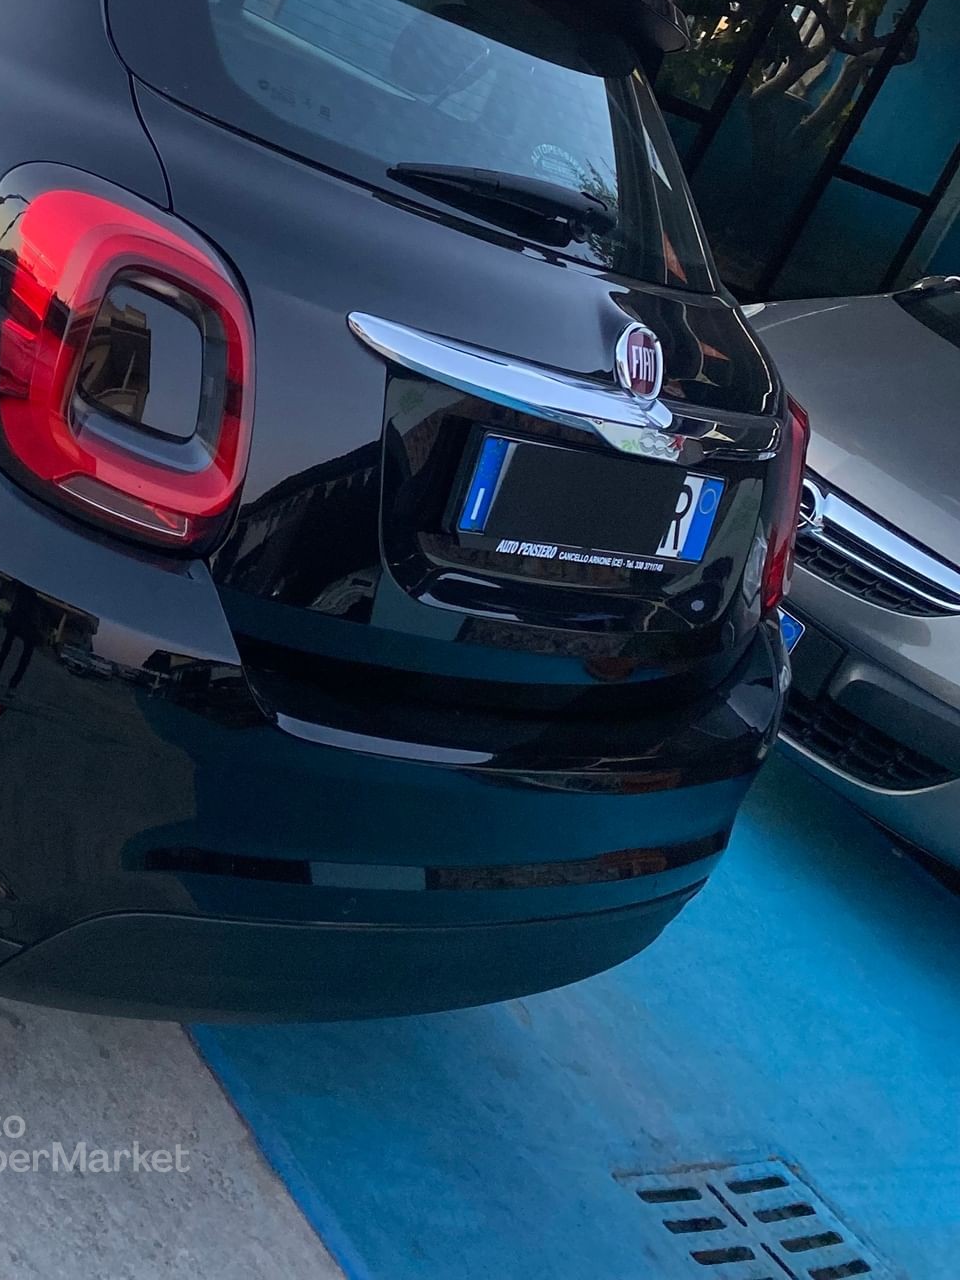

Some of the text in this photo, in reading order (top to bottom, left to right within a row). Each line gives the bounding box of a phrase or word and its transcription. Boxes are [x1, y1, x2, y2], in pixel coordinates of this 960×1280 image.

[631, 345, 655, 382] FIAT
[496, 539, 519, 554] AUTO
[517, 542, 558, 559] PENSIERO
[558, 551, 589, 563] CANCELLO
[588, 554, 613, 566] ARNONE
